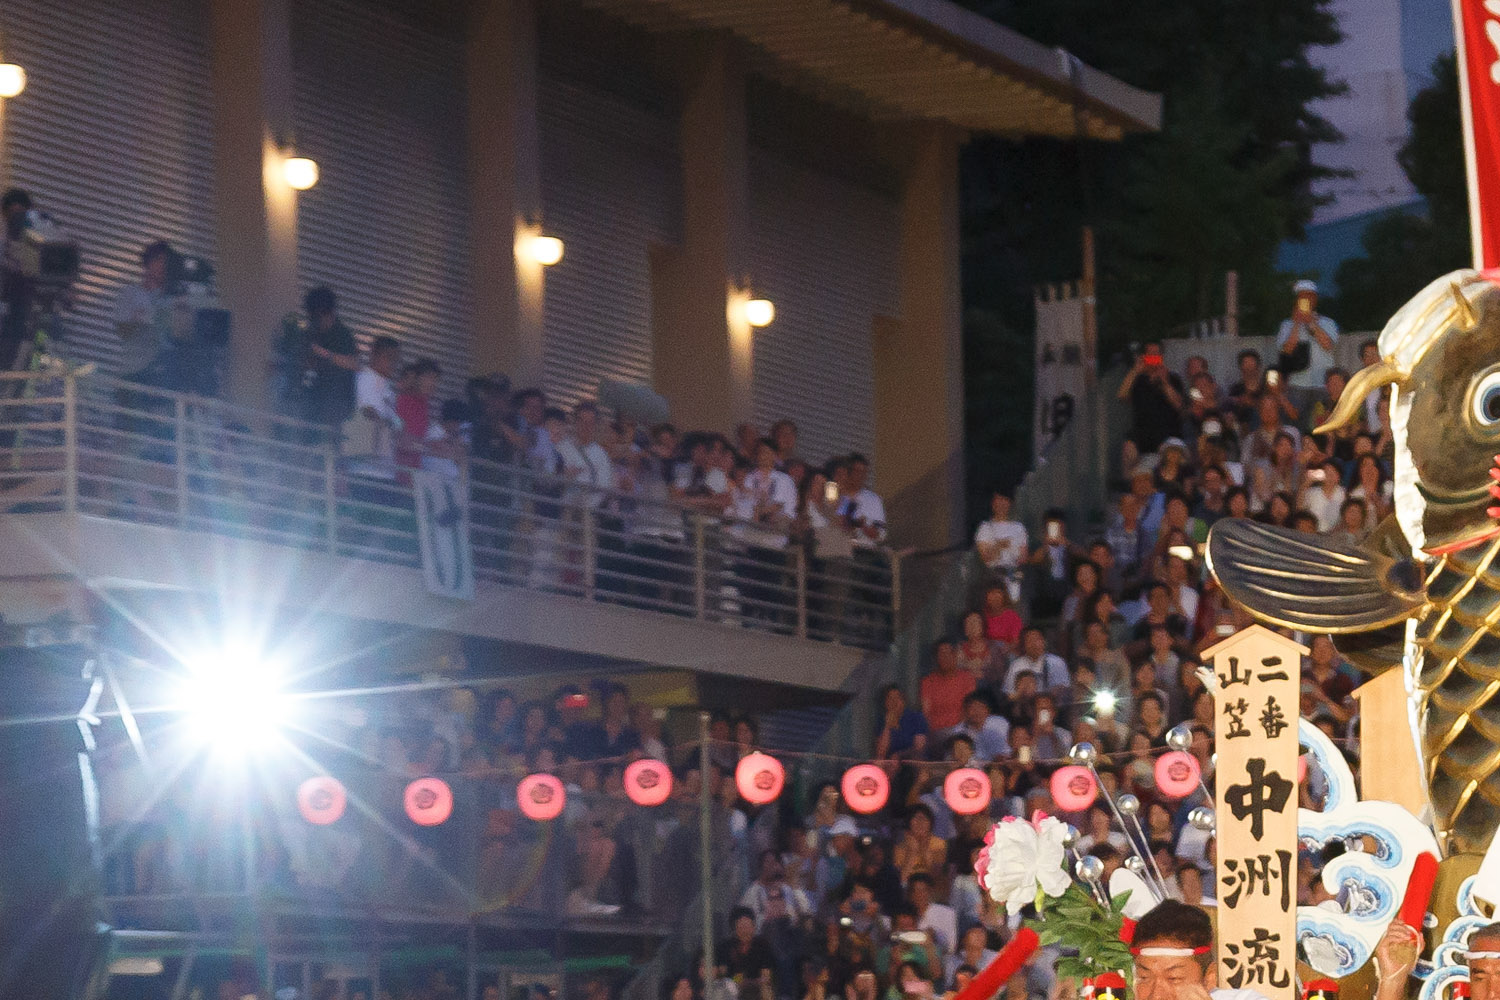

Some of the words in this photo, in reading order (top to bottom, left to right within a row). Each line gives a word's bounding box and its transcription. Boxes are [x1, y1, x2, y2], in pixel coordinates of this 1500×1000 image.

[1218, 656, 1252, 740] 山笠
[1257, 656, 1290, 740] 二番
[1221, 757, 1294, 989] 中洲流
